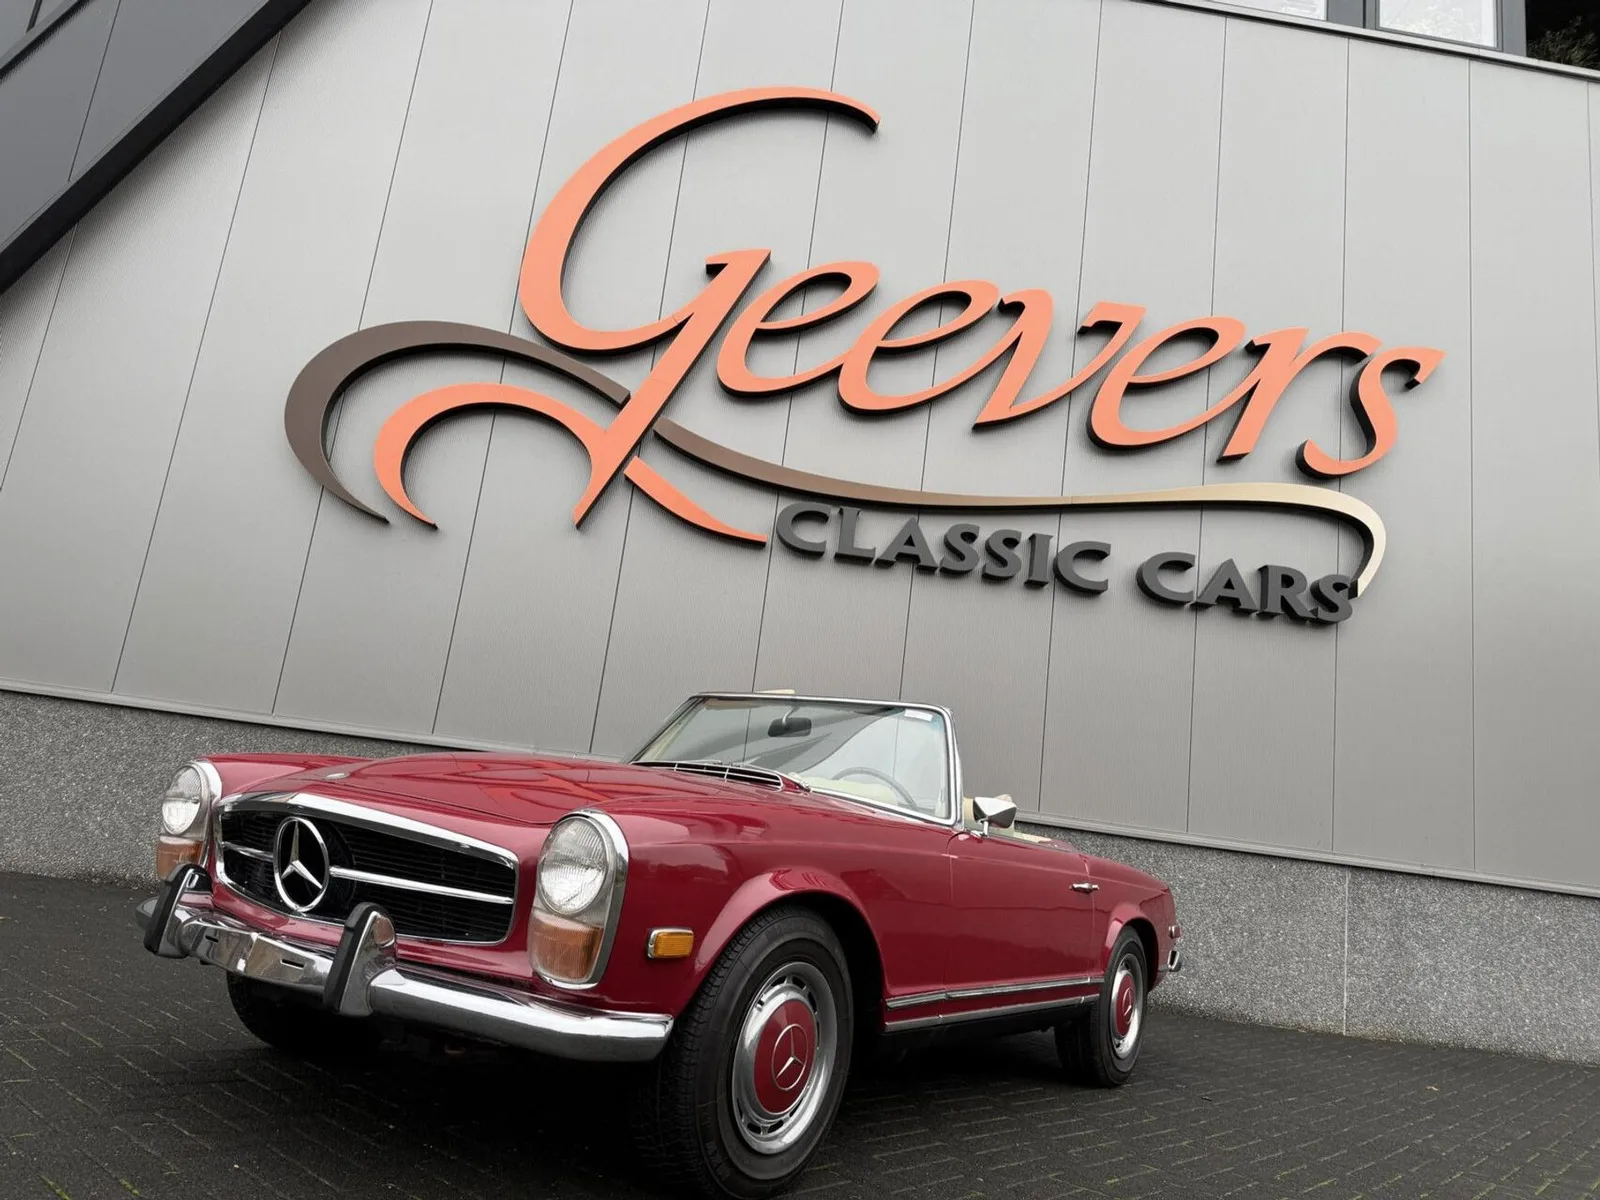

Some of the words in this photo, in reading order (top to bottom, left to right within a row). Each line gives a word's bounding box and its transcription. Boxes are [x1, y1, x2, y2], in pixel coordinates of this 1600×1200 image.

[373, 86, 1446, 528] Geevers
[775, 501, 1111, 595] CLASSIC
[1136, 551, 1355, 625] CARS
